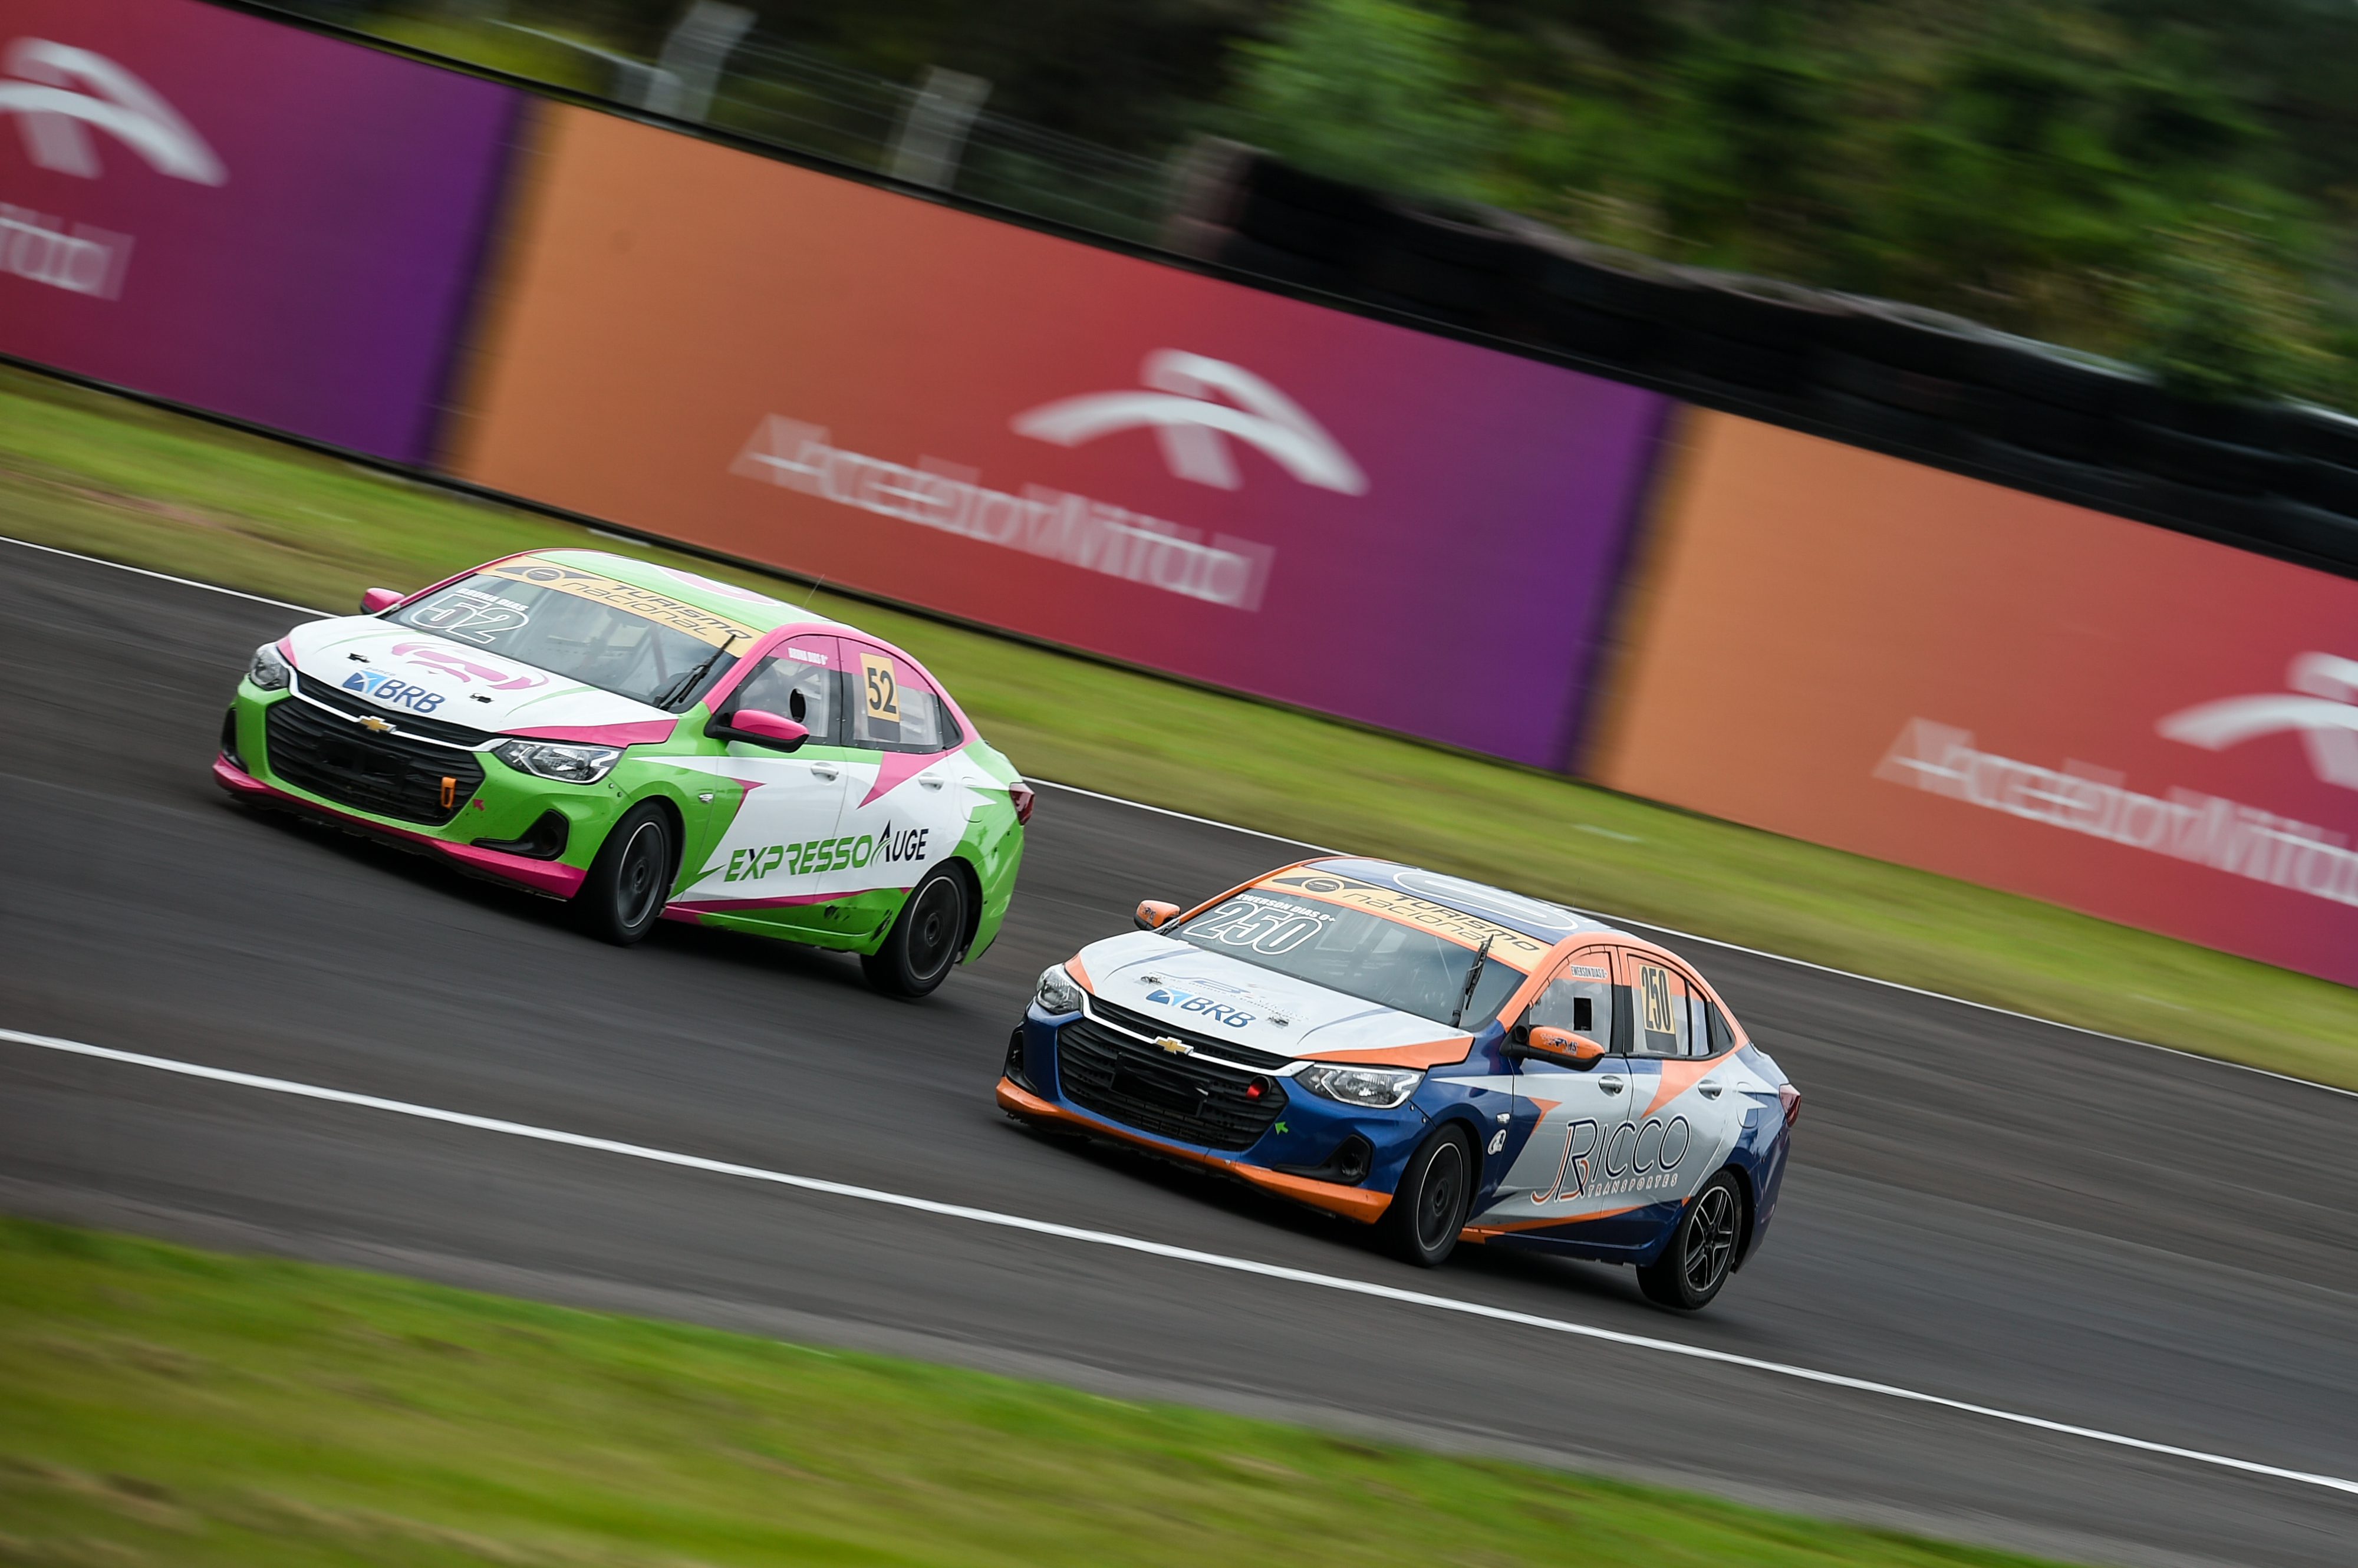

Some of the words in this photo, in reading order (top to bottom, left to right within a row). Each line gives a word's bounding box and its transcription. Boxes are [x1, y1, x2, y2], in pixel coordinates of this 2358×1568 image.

[410, 593, 529, 644] 52
[561, 582, 708, 636] nacional
[612, 584, 753, 640] TURISMO
[374, 678, 446, 713] BRB
[867, 667, 897, 714] 52
[1182, 900, 1323, 956] 250
[1235, 894, 1292, 910] EWERSON
[1290, 905, 1320, 918] DIAS
[1393, 894, 1541, 951] TURISMO
[1180, 997, 1257, 1028] BRB
[1641, 966, 1671, 1032] 250
[1587, 1173, 1679, 1199] TRANSPORTES
